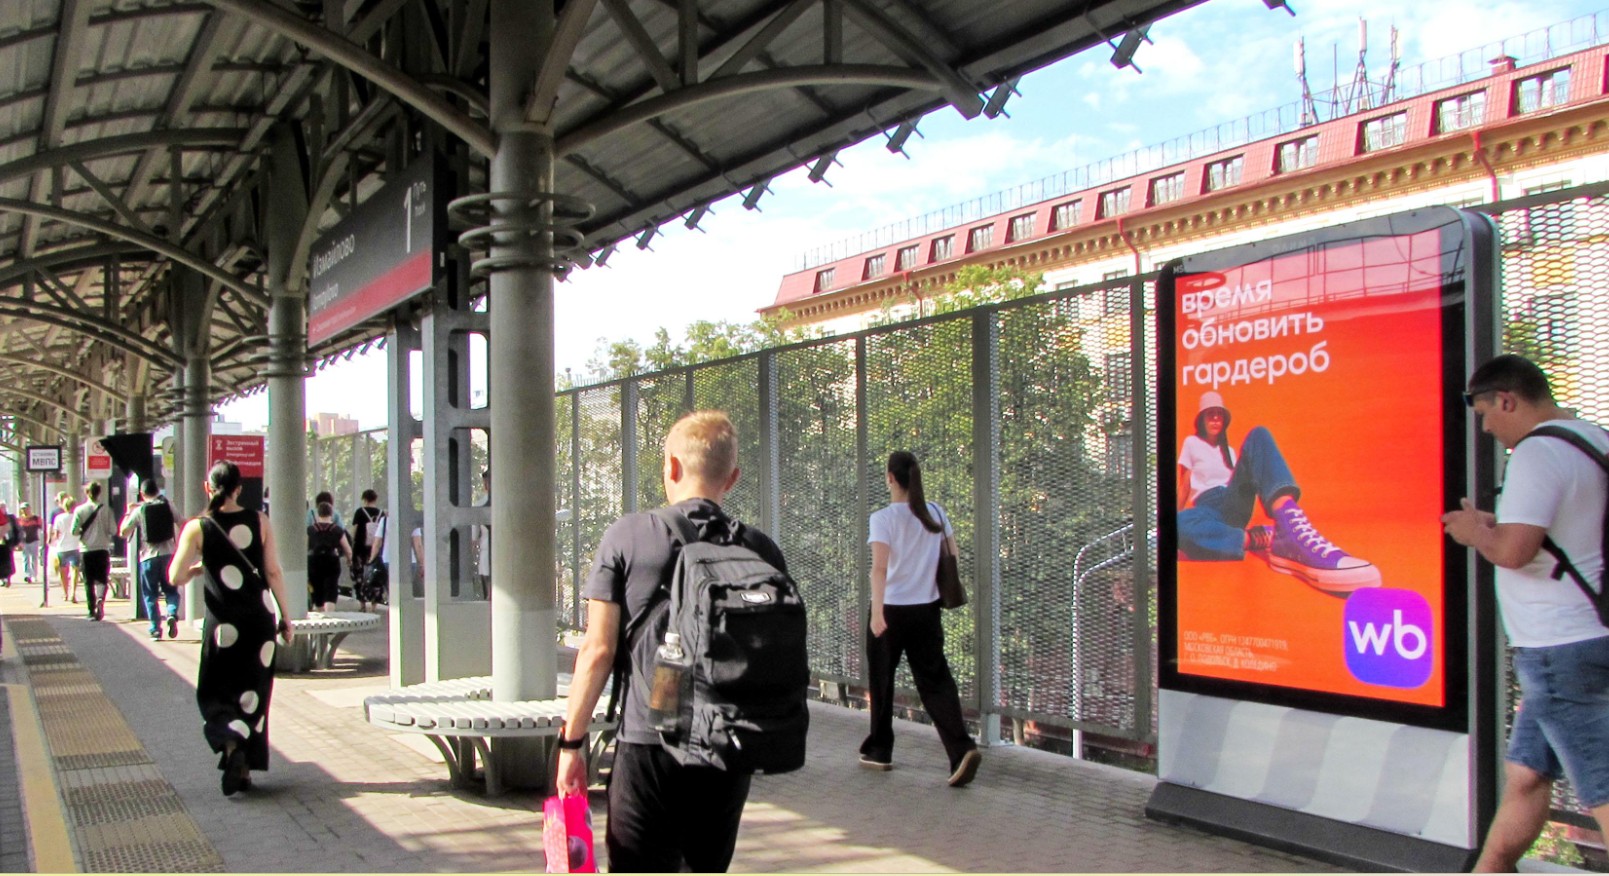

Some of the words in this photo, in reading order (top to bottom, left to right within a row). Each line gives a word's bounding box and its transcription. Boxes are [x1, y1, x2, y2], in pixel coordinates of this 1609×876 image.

[313, 233, 355, 279] Измайлово
[1181, 279, 1272, 318] время
[1181, 312, 1324, 350] обновить
[1181, 341, 1330, 390] гардероб
[32, 457, 57, 466] МВПС
[1184, 630, 1198, 641] ООО
[1348, 609, 1427, 660] wb
